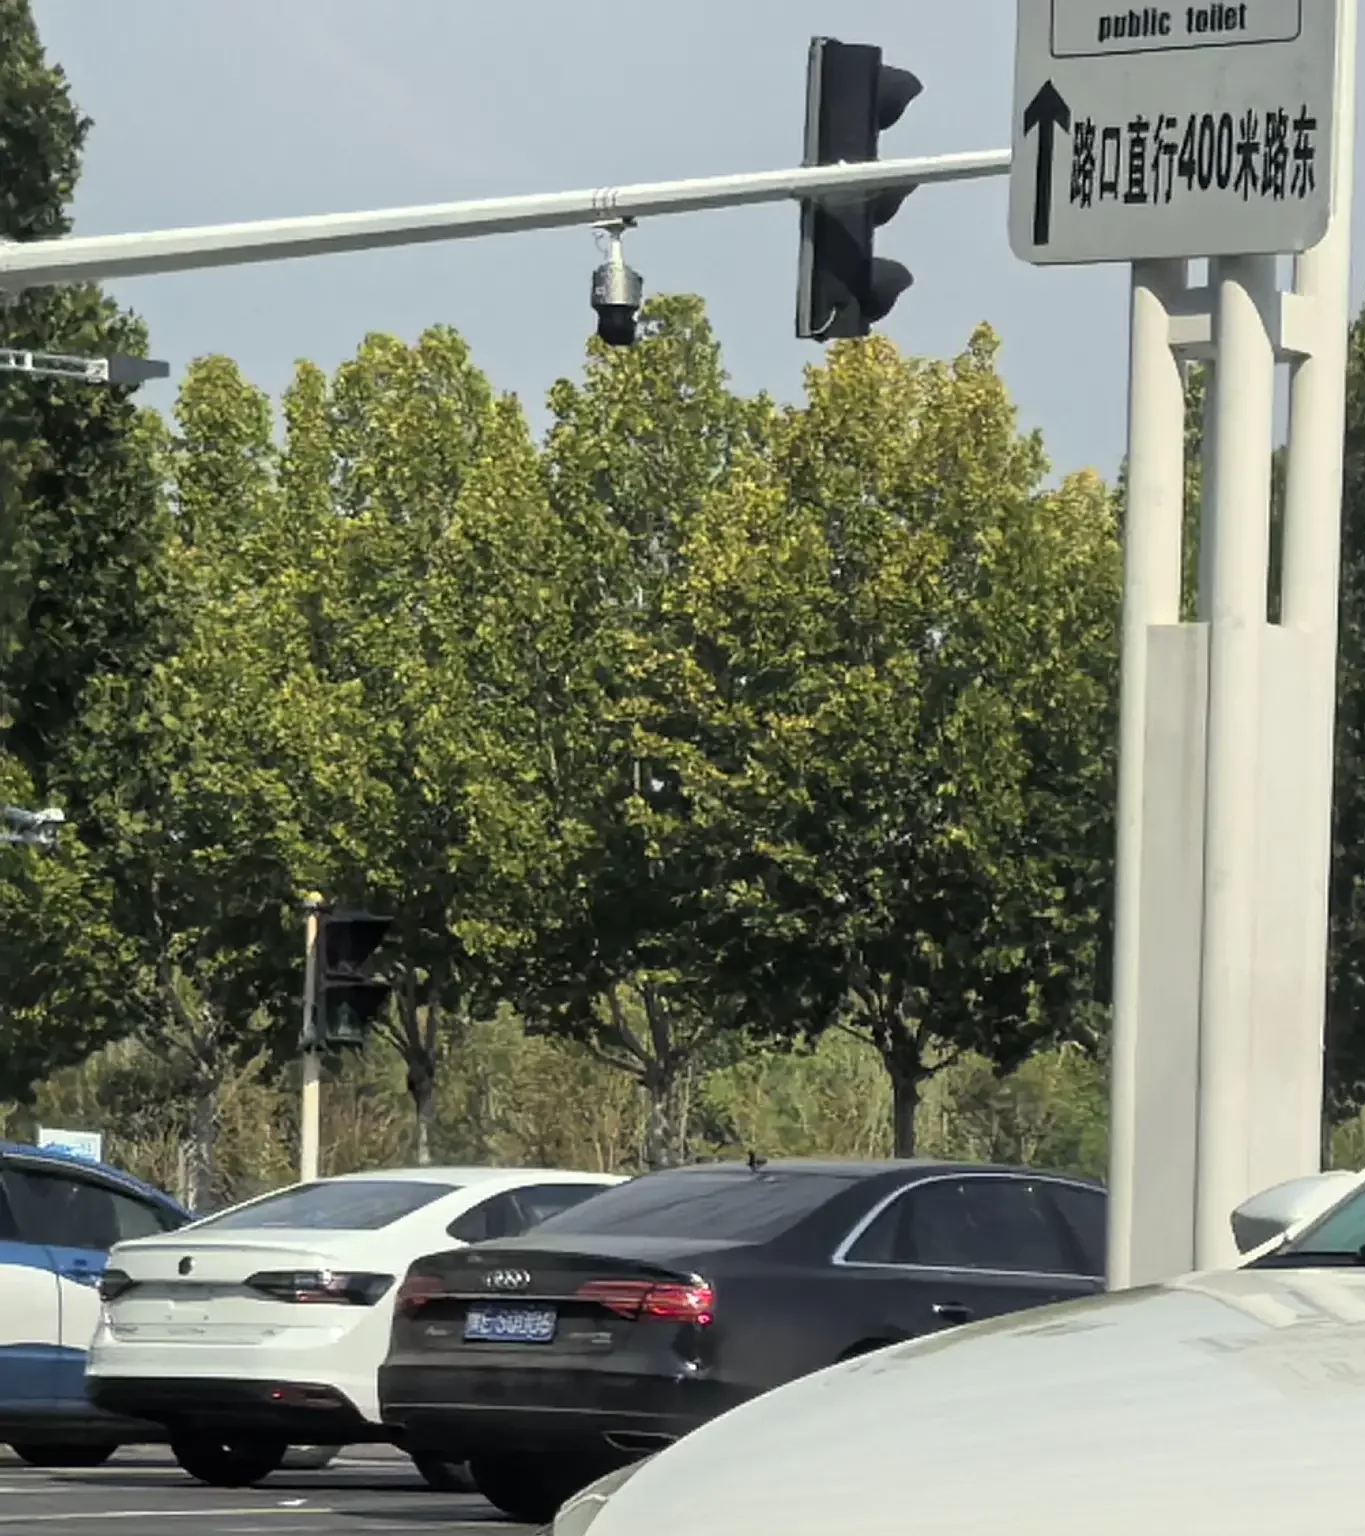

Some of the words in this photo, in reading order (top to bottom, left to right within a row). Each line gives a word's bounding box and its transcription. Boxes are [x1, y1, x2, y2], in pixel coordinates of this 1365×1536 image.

[1098, 7, 1171, 42] public
[1186, 2, 1246, 34] toilet
[1070, 104, 1317, 208] 路口直行400米路东
